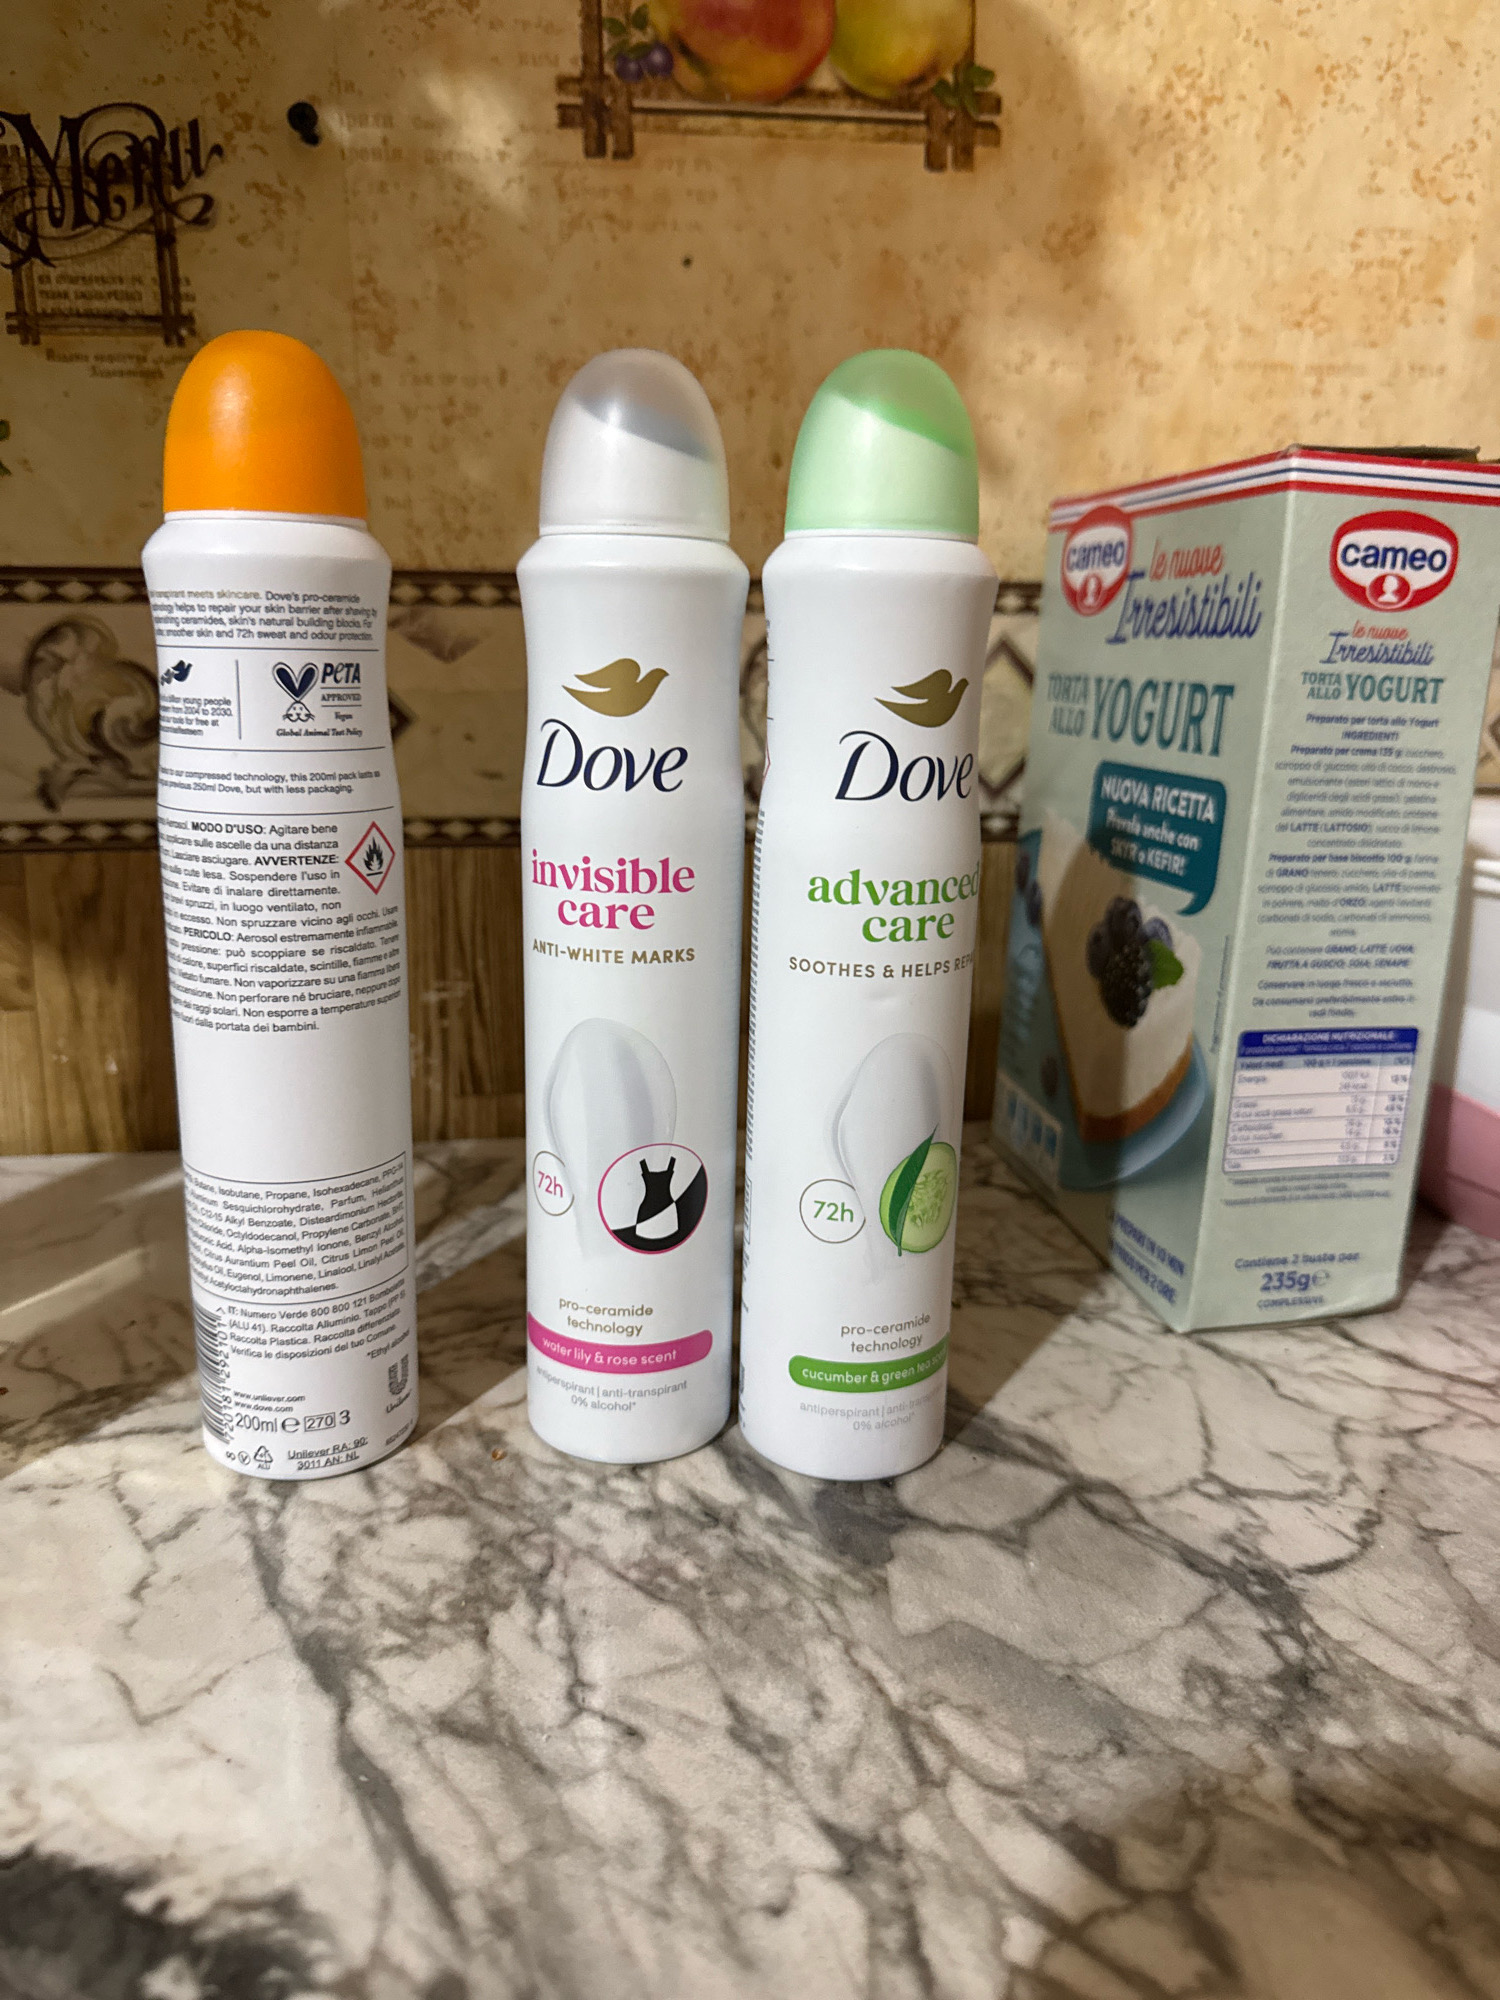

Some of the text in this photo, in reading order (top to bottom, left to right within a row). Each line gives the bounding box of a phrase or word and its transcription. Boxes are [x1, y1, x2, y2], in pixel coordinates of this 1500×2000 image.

[0, 103, 223, 266] Menu
[1066, 540, 1126, 572] cameo
[1341, 544, 1448, 572] cameo
[266, 590, 299, 601] Dove's
[240, 605, 320, 614] your skin barrier
[229, 616, 334, 630] skin's natural building
[216, 629, 234, 638] and
[236, 629, 254, 638] 72h
[257, 631, 286, 639] sweat
[290, 630, 308, 639] and
[1302, 671, 1342, 686] TORTA
[1306, 686, 1342, 700] ALLO
[1346, 674, 1446, 704] YOGURT
[1091, 677, 1235, 757] YOGURT
[536, 718, 688, 792] Dove
[835, 730, 974, 802] Dove
[234, 772, 336, 783] technology, this 200ml
[218, 784, 243, 794] Dove,
[1101, 775, 1216, 824] NUOVA RICETTA
[192, 822, 223, 832] MODO
[269, 825, 308, 837] Agitare
[311, 824, 338, 834] bene
[216, 840, 338, 850] ascelle da una distanza
[230, 870, 297, 882] Sospendere
[532, 848, 696, 894] invisible
[226, 886, 263, 896] inalare
[808, 860, 980, 906] advanced
[233, 902, 264, 914] luogo
[558, 900, 655, 930] care
[241, 914, 354, 928] spruzzare vicino agli
[862, 912, 954, 943] care
[236, 933, 278, 942] Aerosol
[280, 930, 354, 942] estremamente
[251, 948, 306, 959] scoppiare
[533, 938, 695, 964] ANTI-WHITE MARKS
[789, 956, 875, 978] SOOTHES
[882, 964, 895, 978] &
[902, 960, 950, 978] HELPS
[240, 994, 290, 1004] perforare
[267, 1009, 309, 1019] esporre
[216, 1022, 250, 1032] portata
[538, 1171, 564, 1198] 72h
[814, 1200, 854, 1222] 72h
[1261, 1270, 1311, 1292] 235g
[311, 1306, 330, 1317] 800
[332, 1302, 350, 1314] 800
[559, 1298, 654, 1317] pro-ceramide
[567, 1316, 643, 1336] technology
[840, 1312, 931, 1338] pro-ceramide
[542, 1338, 676, 1366] water lily & rose scent
[851, 1334, 922, 1353] technology
[802, 1366, 915, 1385] cucumber & green
[602, 1380, 688, 1398] anti-transpirant
[572, 1395, 588, 1408] 0%
[800, 1400, 880, 1418] antiperspirant
[236, 1412, 334, 1433] 200ml 270
[852, 1420, 872, 1431] 0%
